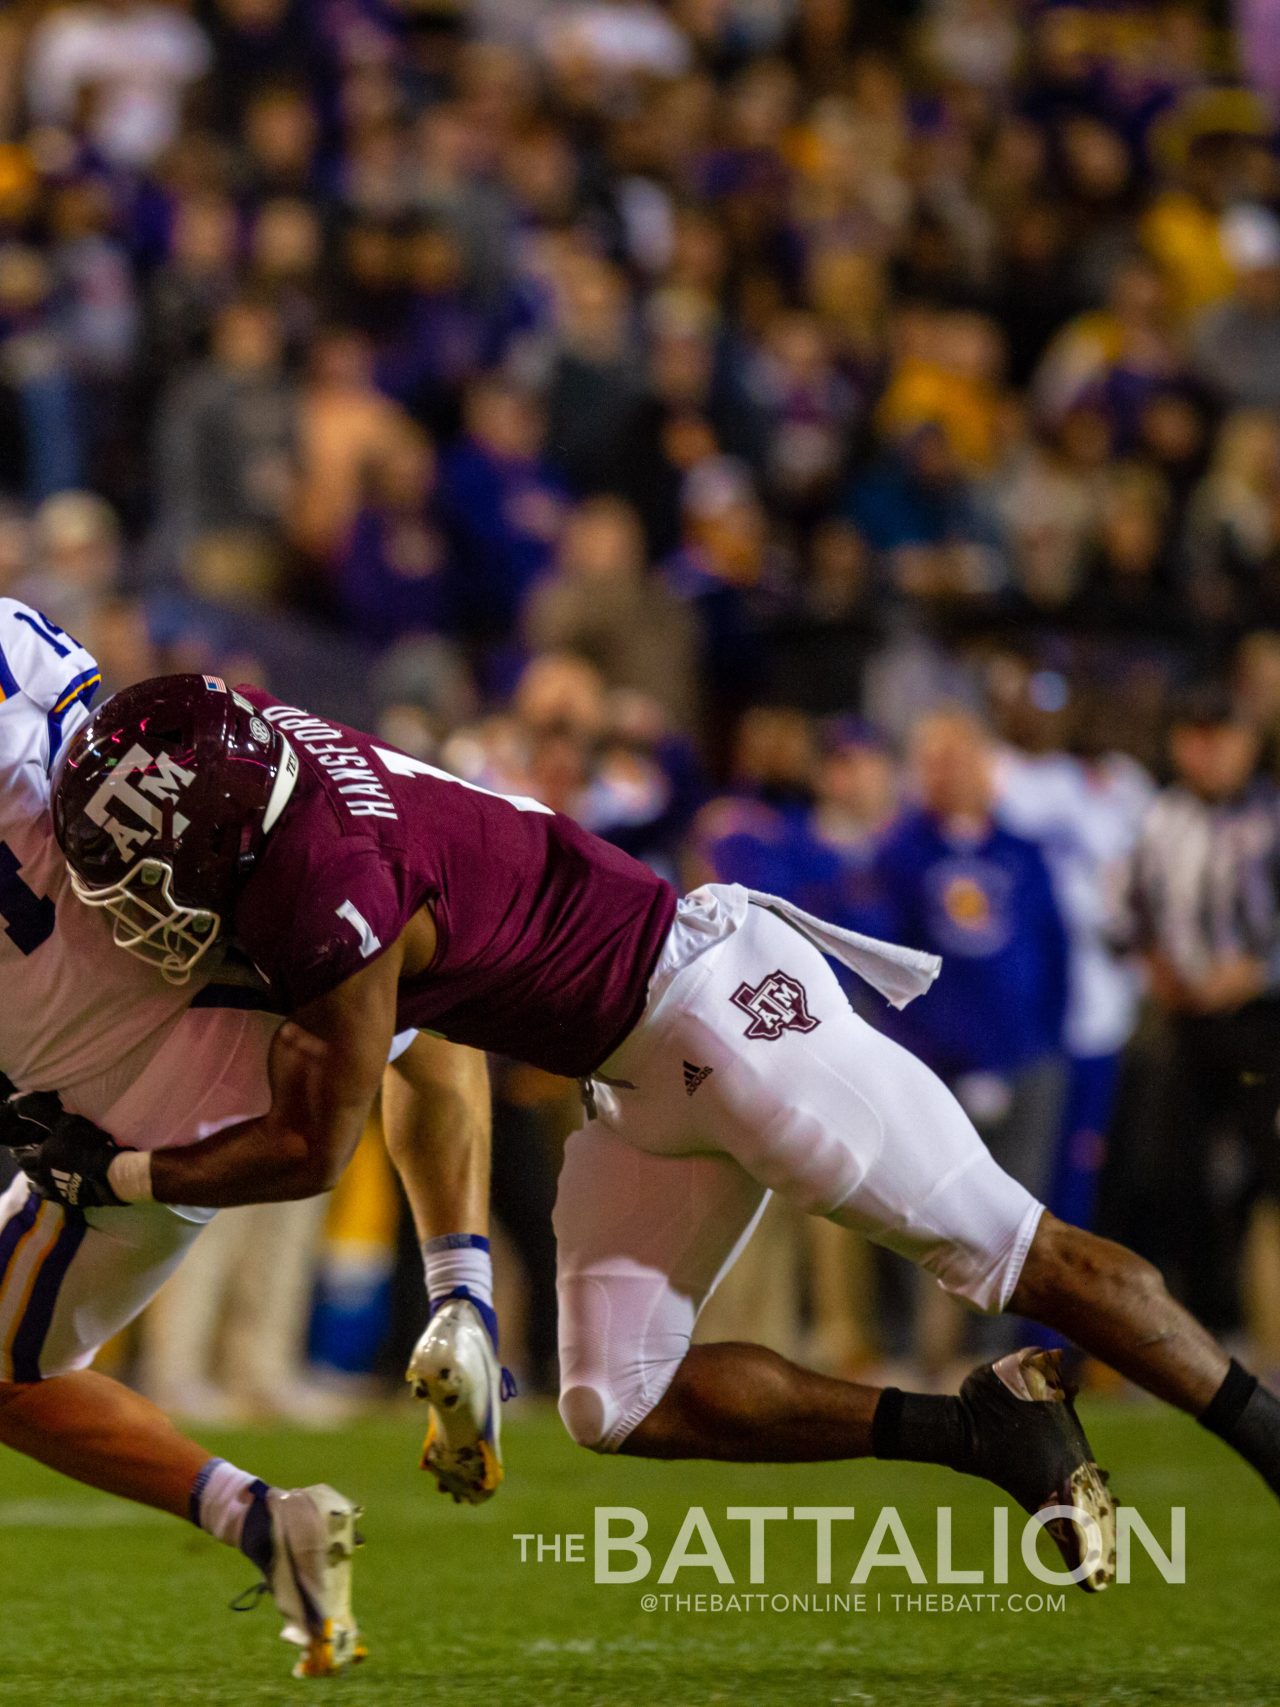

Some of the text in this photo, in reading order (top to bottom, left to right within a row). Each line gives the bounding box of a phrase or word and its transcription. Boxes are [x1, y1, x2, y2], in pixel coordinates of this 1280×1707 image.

[262, 705, 398, 820] HANSFORD
[335, 899, 381, 959] 1
[686, 1065, 714, 1097] adidas
